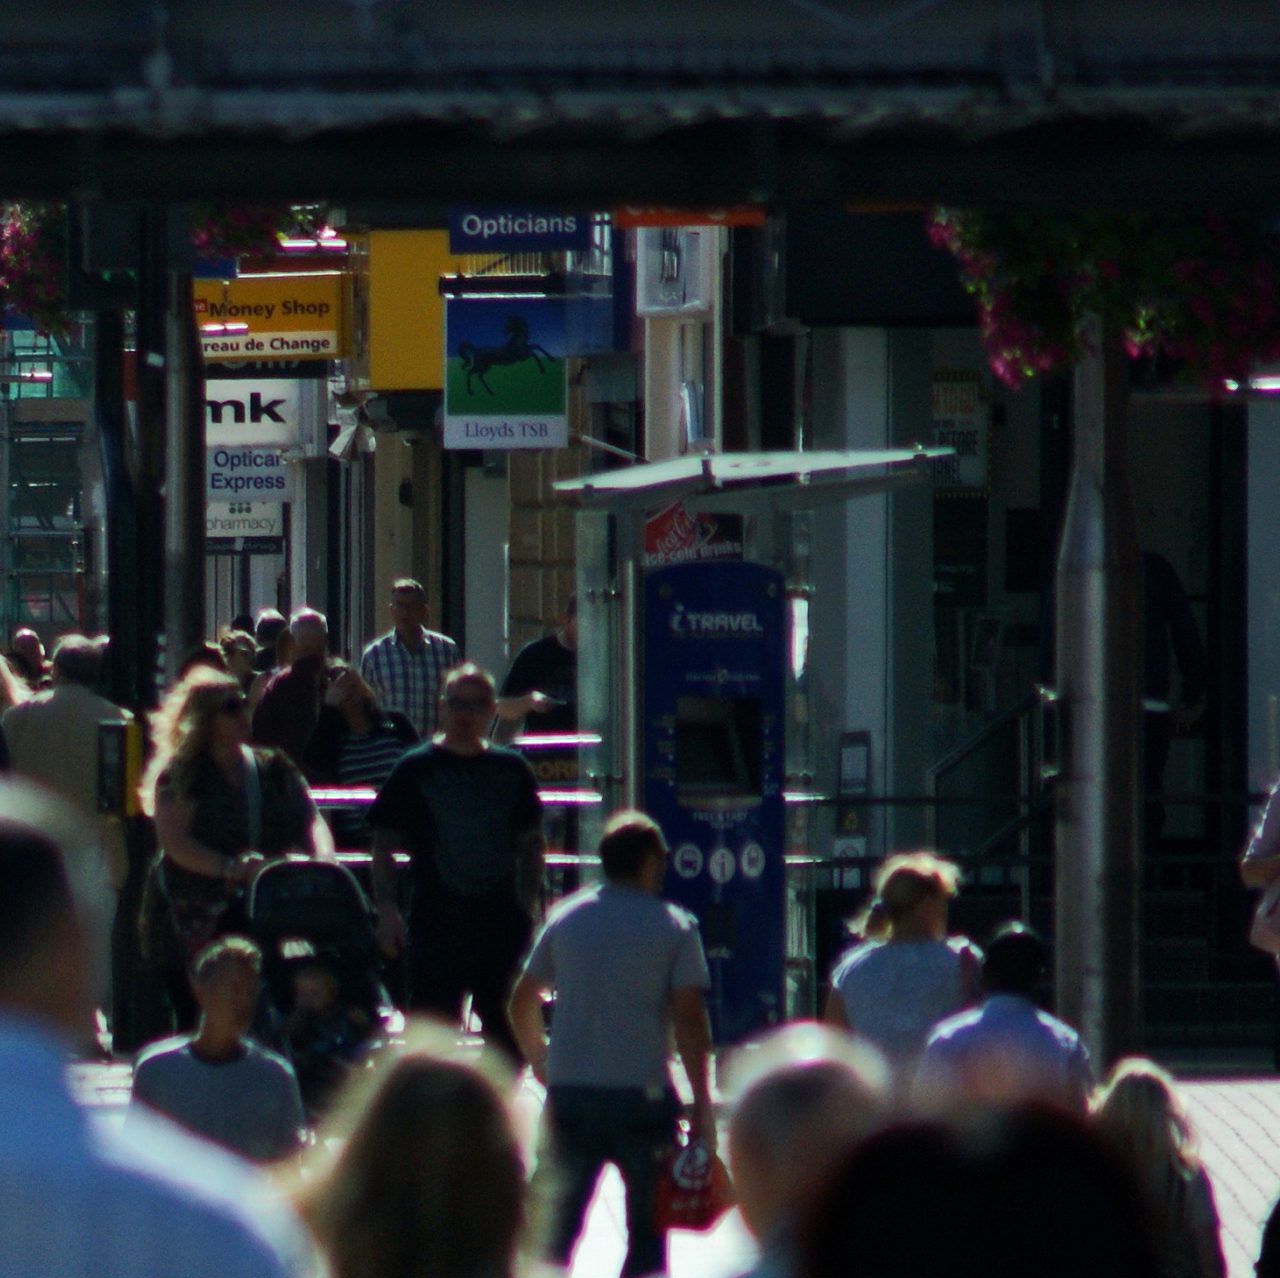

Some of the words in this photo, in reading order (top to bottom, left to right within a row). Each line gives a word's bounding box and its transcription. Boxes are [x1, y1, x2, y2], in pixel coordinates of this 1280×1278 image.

[462, 213, 577, 239] Opticians
[209, 302, 276, 319] Money
[281, 300, 330, 317] Shop
[202, 341, 239, 352] reau
[245, 338, 264, 351] de
[270, 338, 330, 352] Change
[465, 422, 514, 441] Lloyds
[519, 423, 548, 437] TSB
[211, 473, 285, 492] Express
